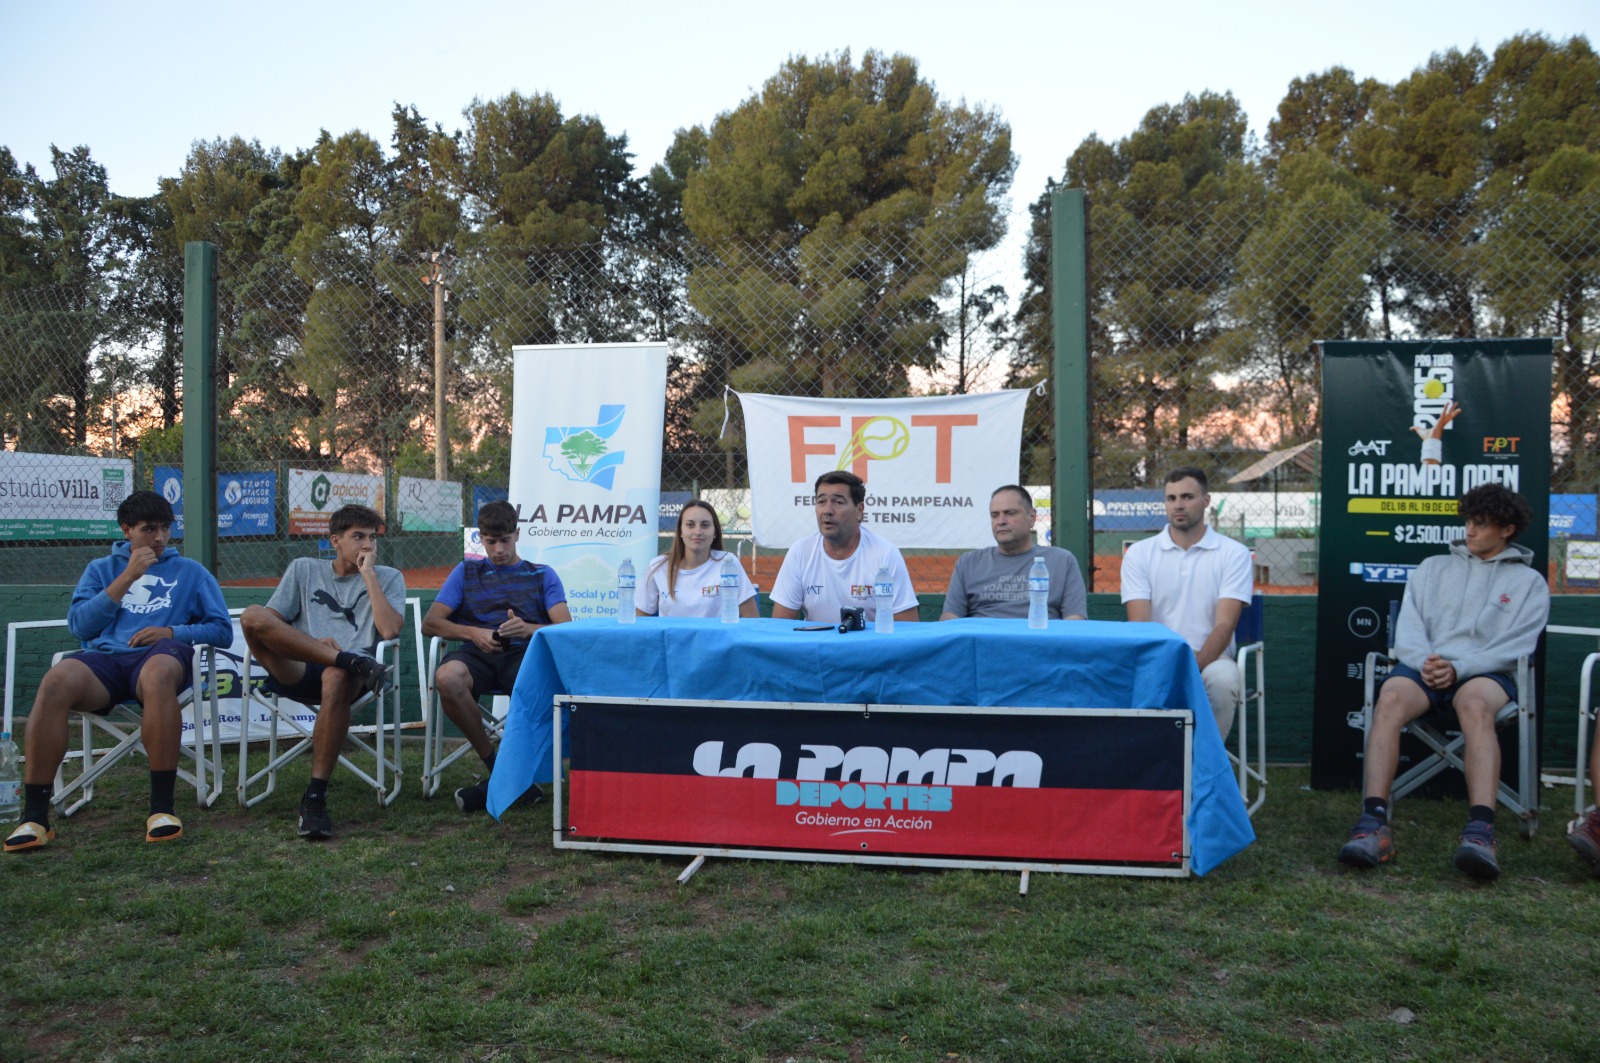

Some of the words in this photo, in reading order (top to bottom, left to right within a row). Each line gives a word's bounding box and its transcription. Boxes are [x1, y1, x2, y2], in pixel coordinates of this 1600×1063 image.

[1414, 354, 1430, 367] PRO
[1433, 354, 1454, 367] TOUR
[787, 414, 978, 484] FPT
[1483, 437, 1521, 453] FPT
[1348, 463, 1374, 495] LA
[1380, 463, 1456, 497] PAMPA
[1462, 464, 1519, 495] OPEN
[240, 497, 270, 505] SEGUROS
[794, 493, 888, 507] FEDÓN
[892, 496, 974, 508] PAMPEANA
[1381, 501, 1395, 511] DEL
[1409, 502, 1419, 512] AL
[1421, 502, 1431, 512] 19
[1432, 502, 1443, 512] DE
[515, 504, 548, 524] LA
[557, 504, 647, 525] PAMPA
[874, 512, 916, 523] TENIS
[528, 526, 575, 537] Gobierno
[581, 528, 593, 537] en
[595, 526, 632, 538] Acción
[569, 589, 598, 599] Social
[600, 592, 607, 602] y
[581, 604, 593, 613] de
[1356, 618, 1372, 627] MN
[693, 741, 782, 779] LA
[796, 745, 1044, 789] PAMPA
[776, 781, 953, 812] DEPORTES
[795, 812, 860, 828] Gobierno
[864, 818, 881, 827] en
[884, 815, 933, 830] Acción
